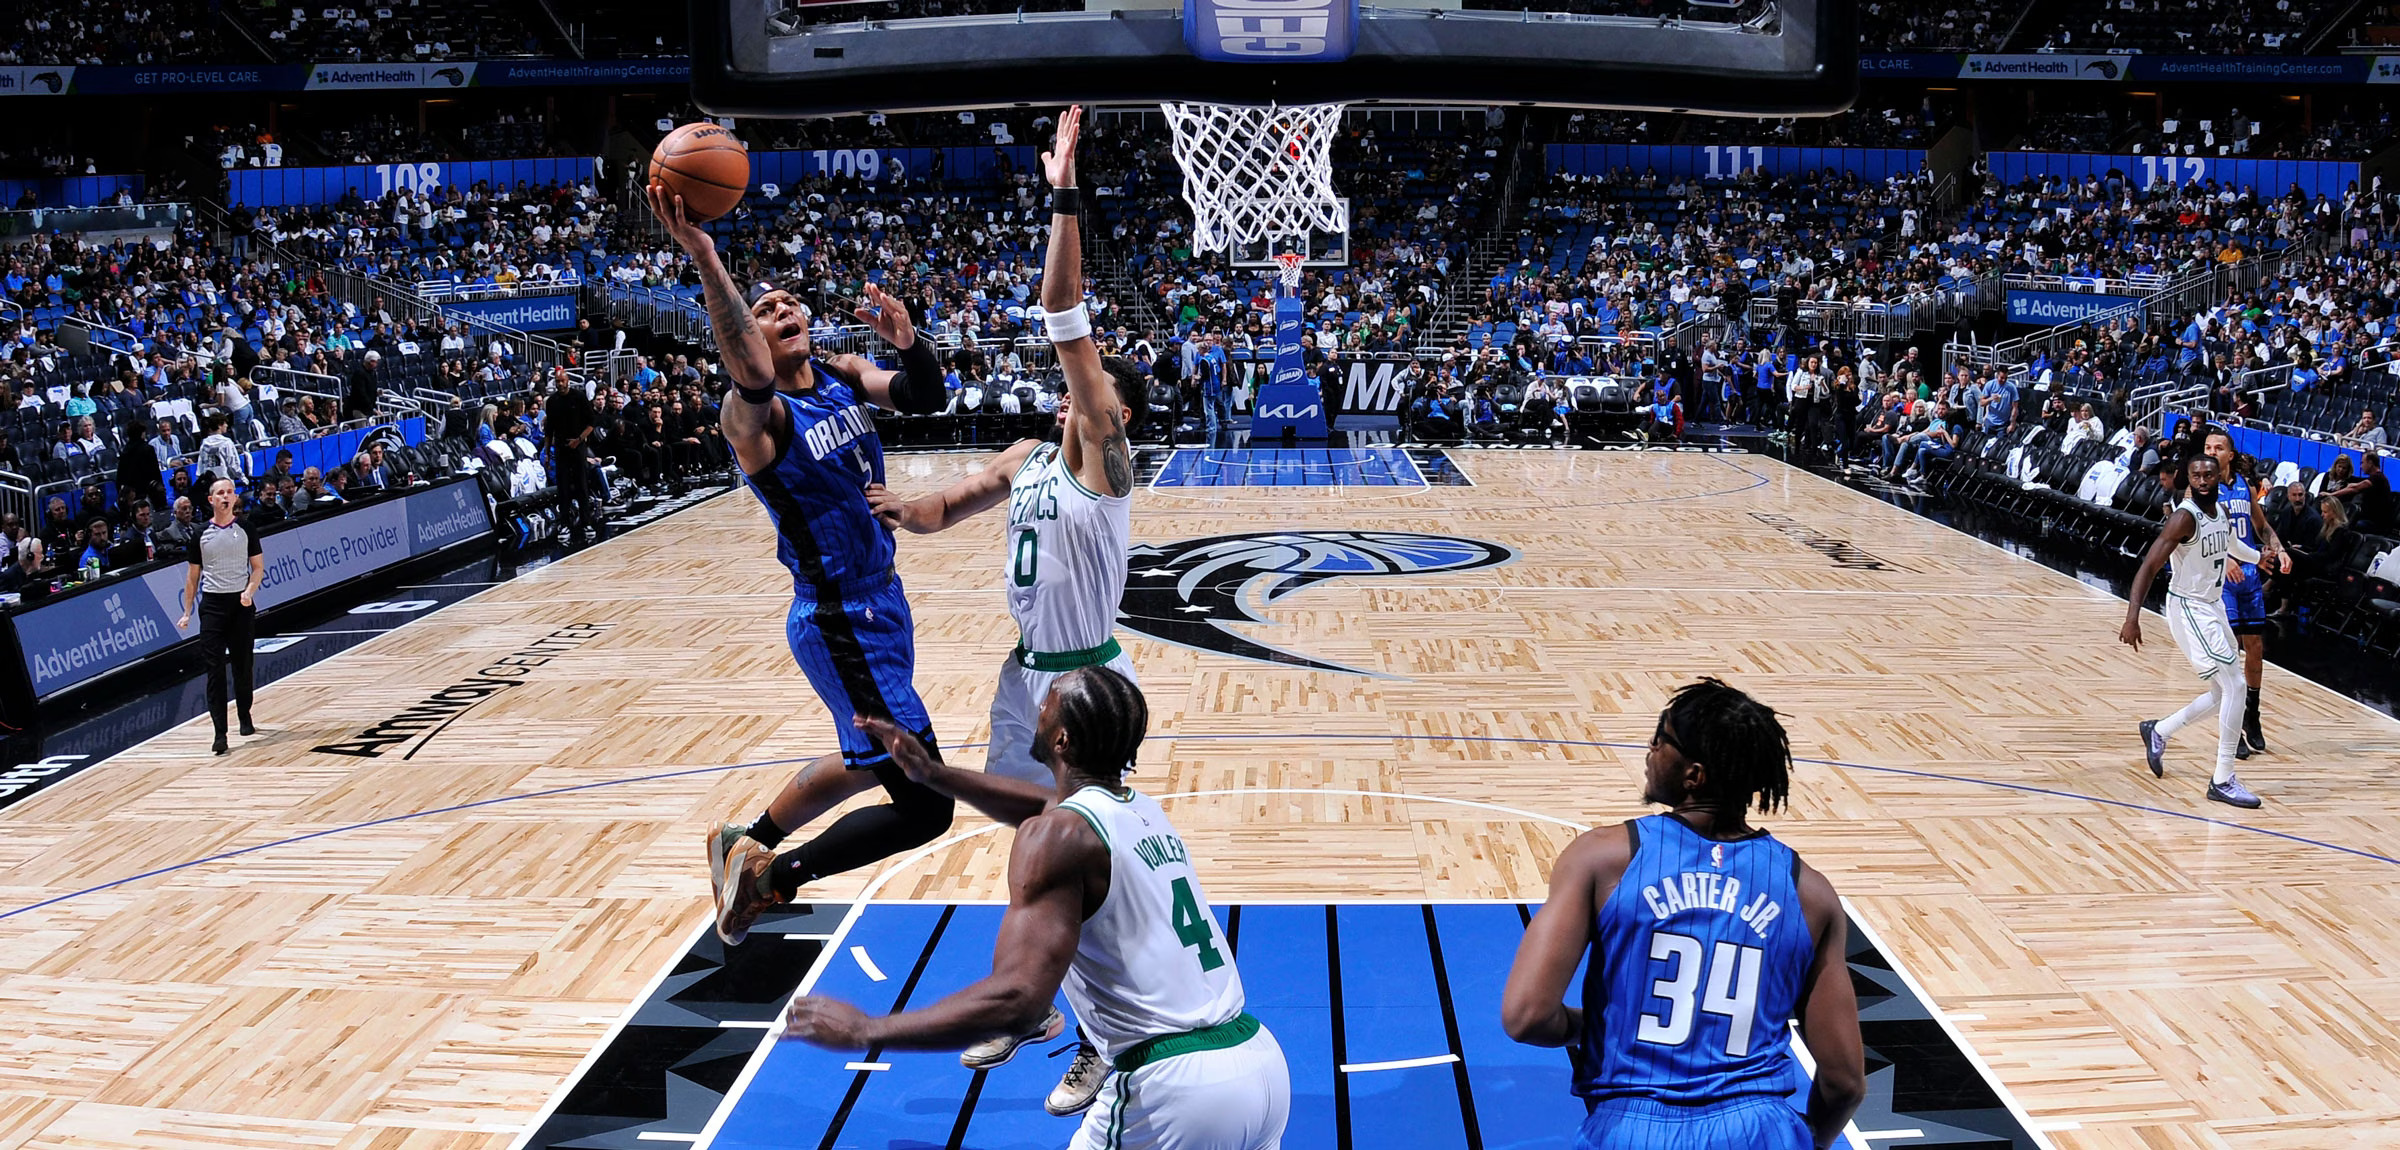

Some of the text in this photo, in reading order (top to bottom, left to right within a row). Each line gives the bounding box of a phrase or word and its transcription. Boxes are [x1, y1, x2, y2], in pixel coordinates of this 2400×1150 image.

[134, 71, 262, 84] GET PRO-LEVEL CARE.
[331, 70, 415, 83] AdventHealth
[1879, 59, 1914, 70] CARE.
[1985, 60, 2068, 74] AdventHealth
[2161, 62, 2342, 76] AdventHealthTrainingCenter.com
[813, 149, 879, 181] 109
[1704, 145, 1763, 180] 111
[2142, 156, 2205, 192] 112
[376, 162, 441, 201] 108
[464, 303, 570, 327] AdventHealth
[1275, 370, 1302, 384] LIBMAN
[805, 404, 876, 461] ORLNDO
[853, 444, 873, 489] 5
[417, 507, 486, 544] AdventHealth
[303, 545, 341, 574] Care
[342, 524, 399, 562] Provider
[1015, 529, 1037, 587] 0
[2214, 558, 2225, 588] 7
[34, 615, 160, 683] AdventHealth
[1133, 834, 1188, 872] VONLEH
[1643, 872, 1780, 939] CARTER JR.
[1171, 876, 1225, 973] 4
[1636, 930, 1763, 1057] 34
